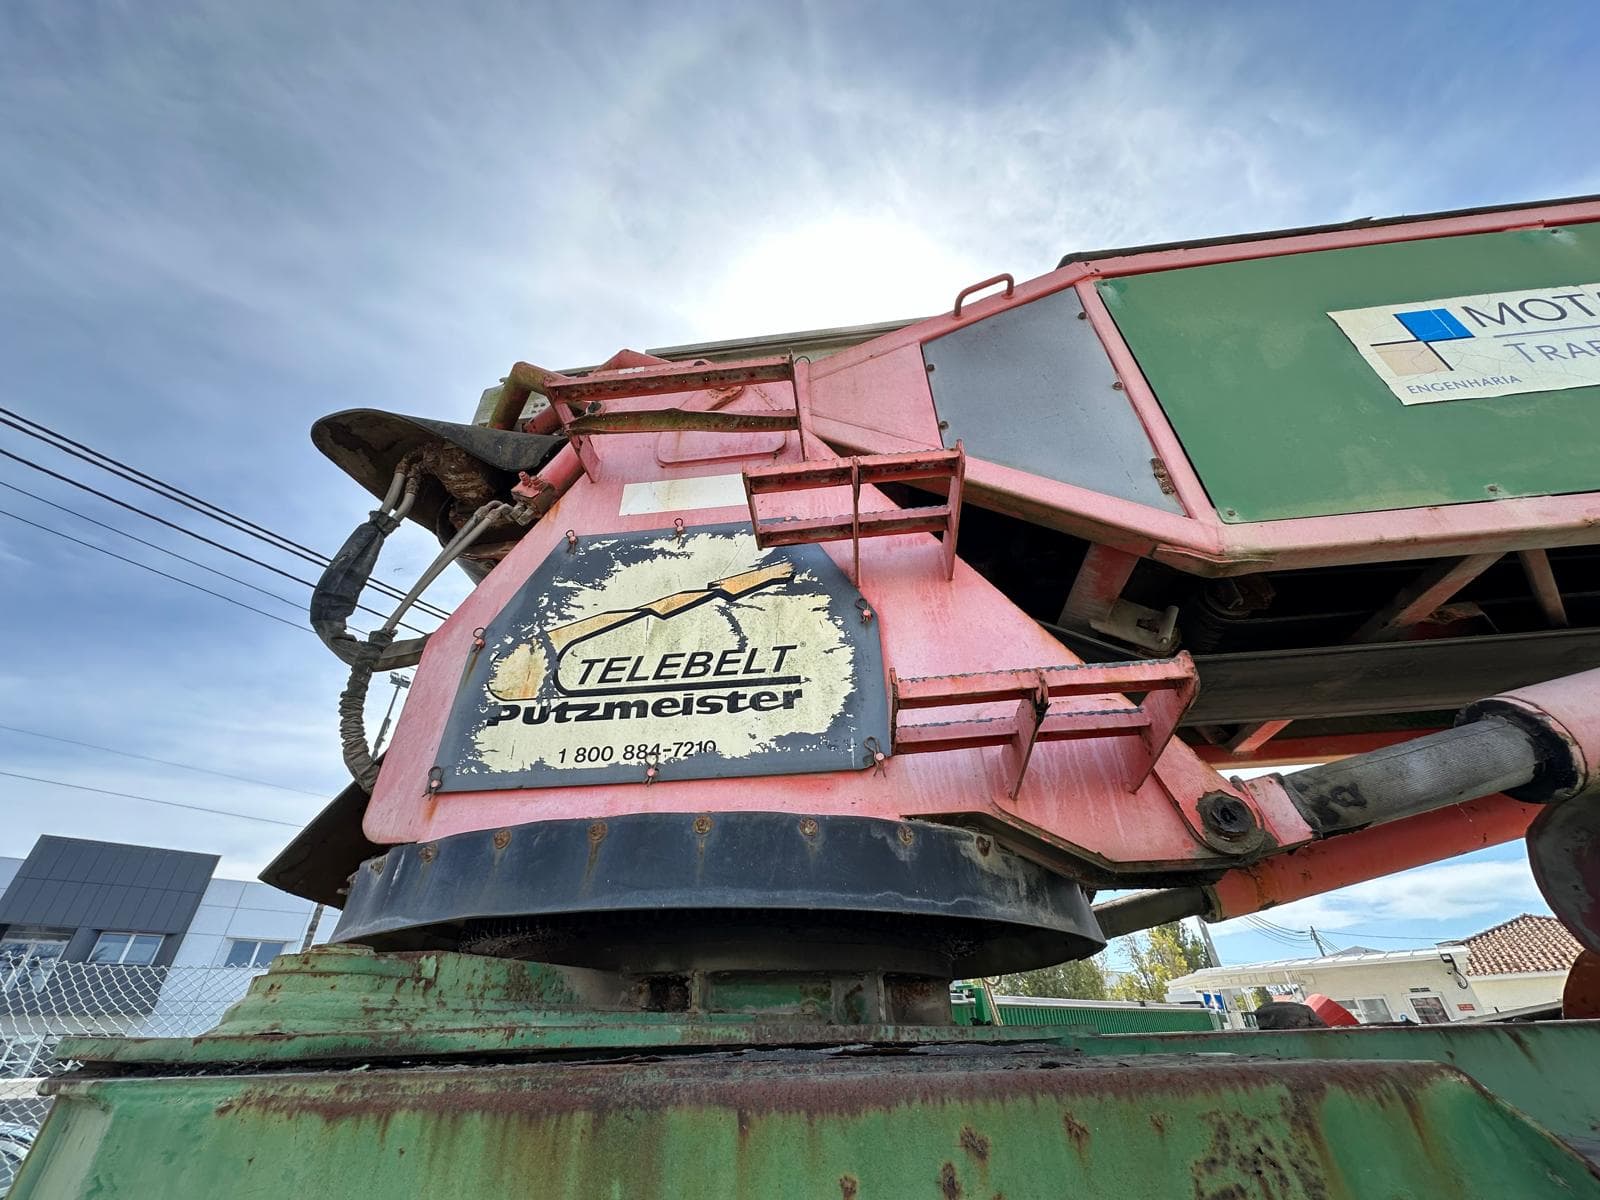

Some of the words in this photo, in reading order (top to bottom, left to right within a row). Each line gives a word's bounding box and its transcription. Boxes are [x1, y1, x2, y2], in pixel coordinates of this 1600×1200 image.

[1461, 292, 1600, 327] MOT
[1406, 374, 1522, 394] ENGENHARIA
[578, 644, 798, 685] TELEBELT
[485, 687, 803, 727] Putzmeister
[558, 748, 567, 763] 1
[574, 745, 614, 763] 800
[622, 739, 717, 760] 884-7210
